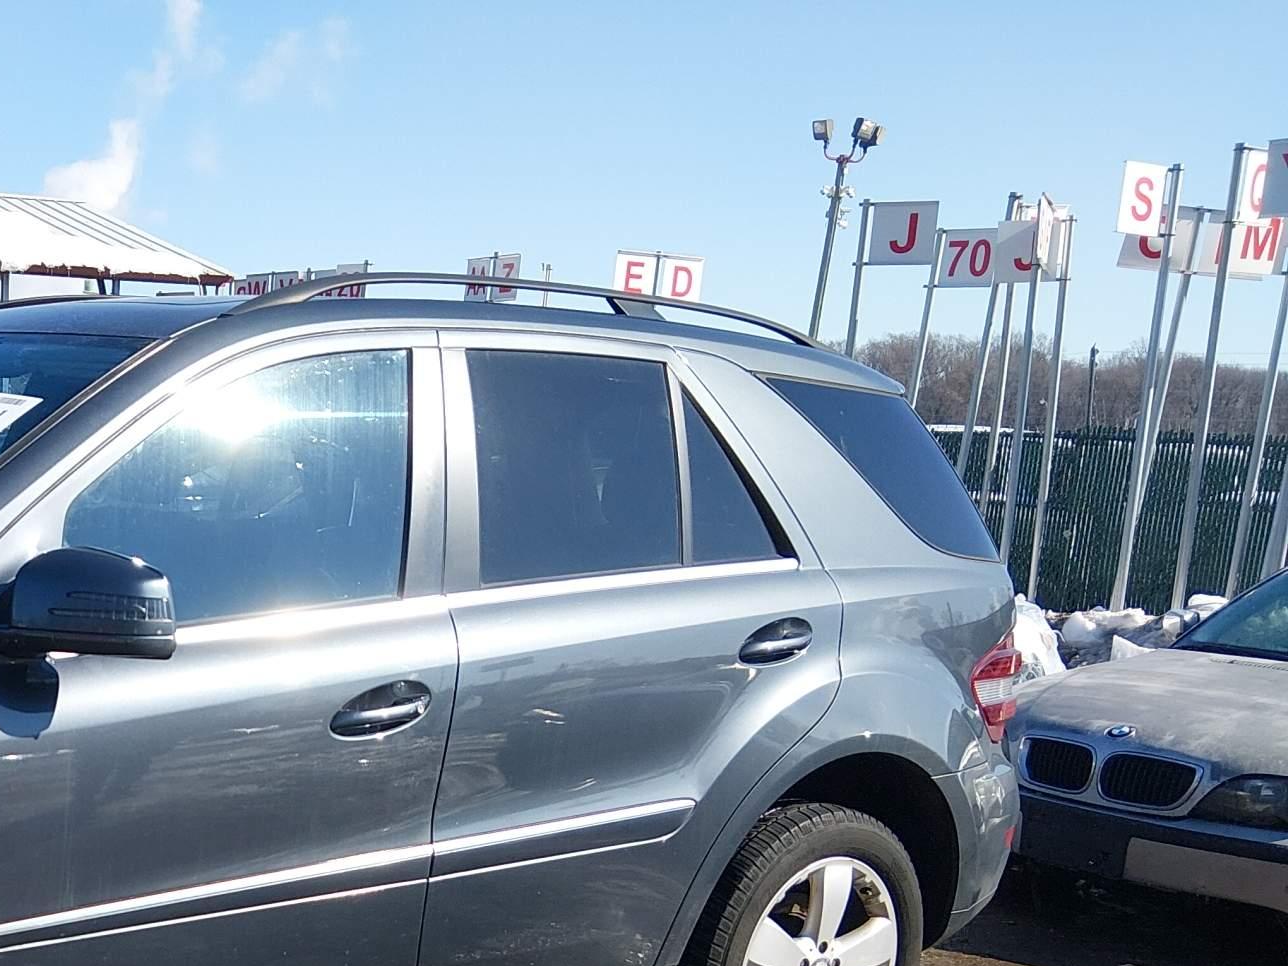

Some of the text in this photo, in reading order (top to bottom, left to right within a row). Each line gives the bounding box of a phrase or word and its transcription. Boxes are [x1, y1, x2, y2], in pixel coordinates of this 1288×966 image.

[1130, 176, 1154, 222] S
[889, 213, 919, 254] J
[1239, 217, 1282, 262] M
[623, 260, 645, 295] E
[947, 239, 991, 277] 70
[670, 265, 693, 298] D
